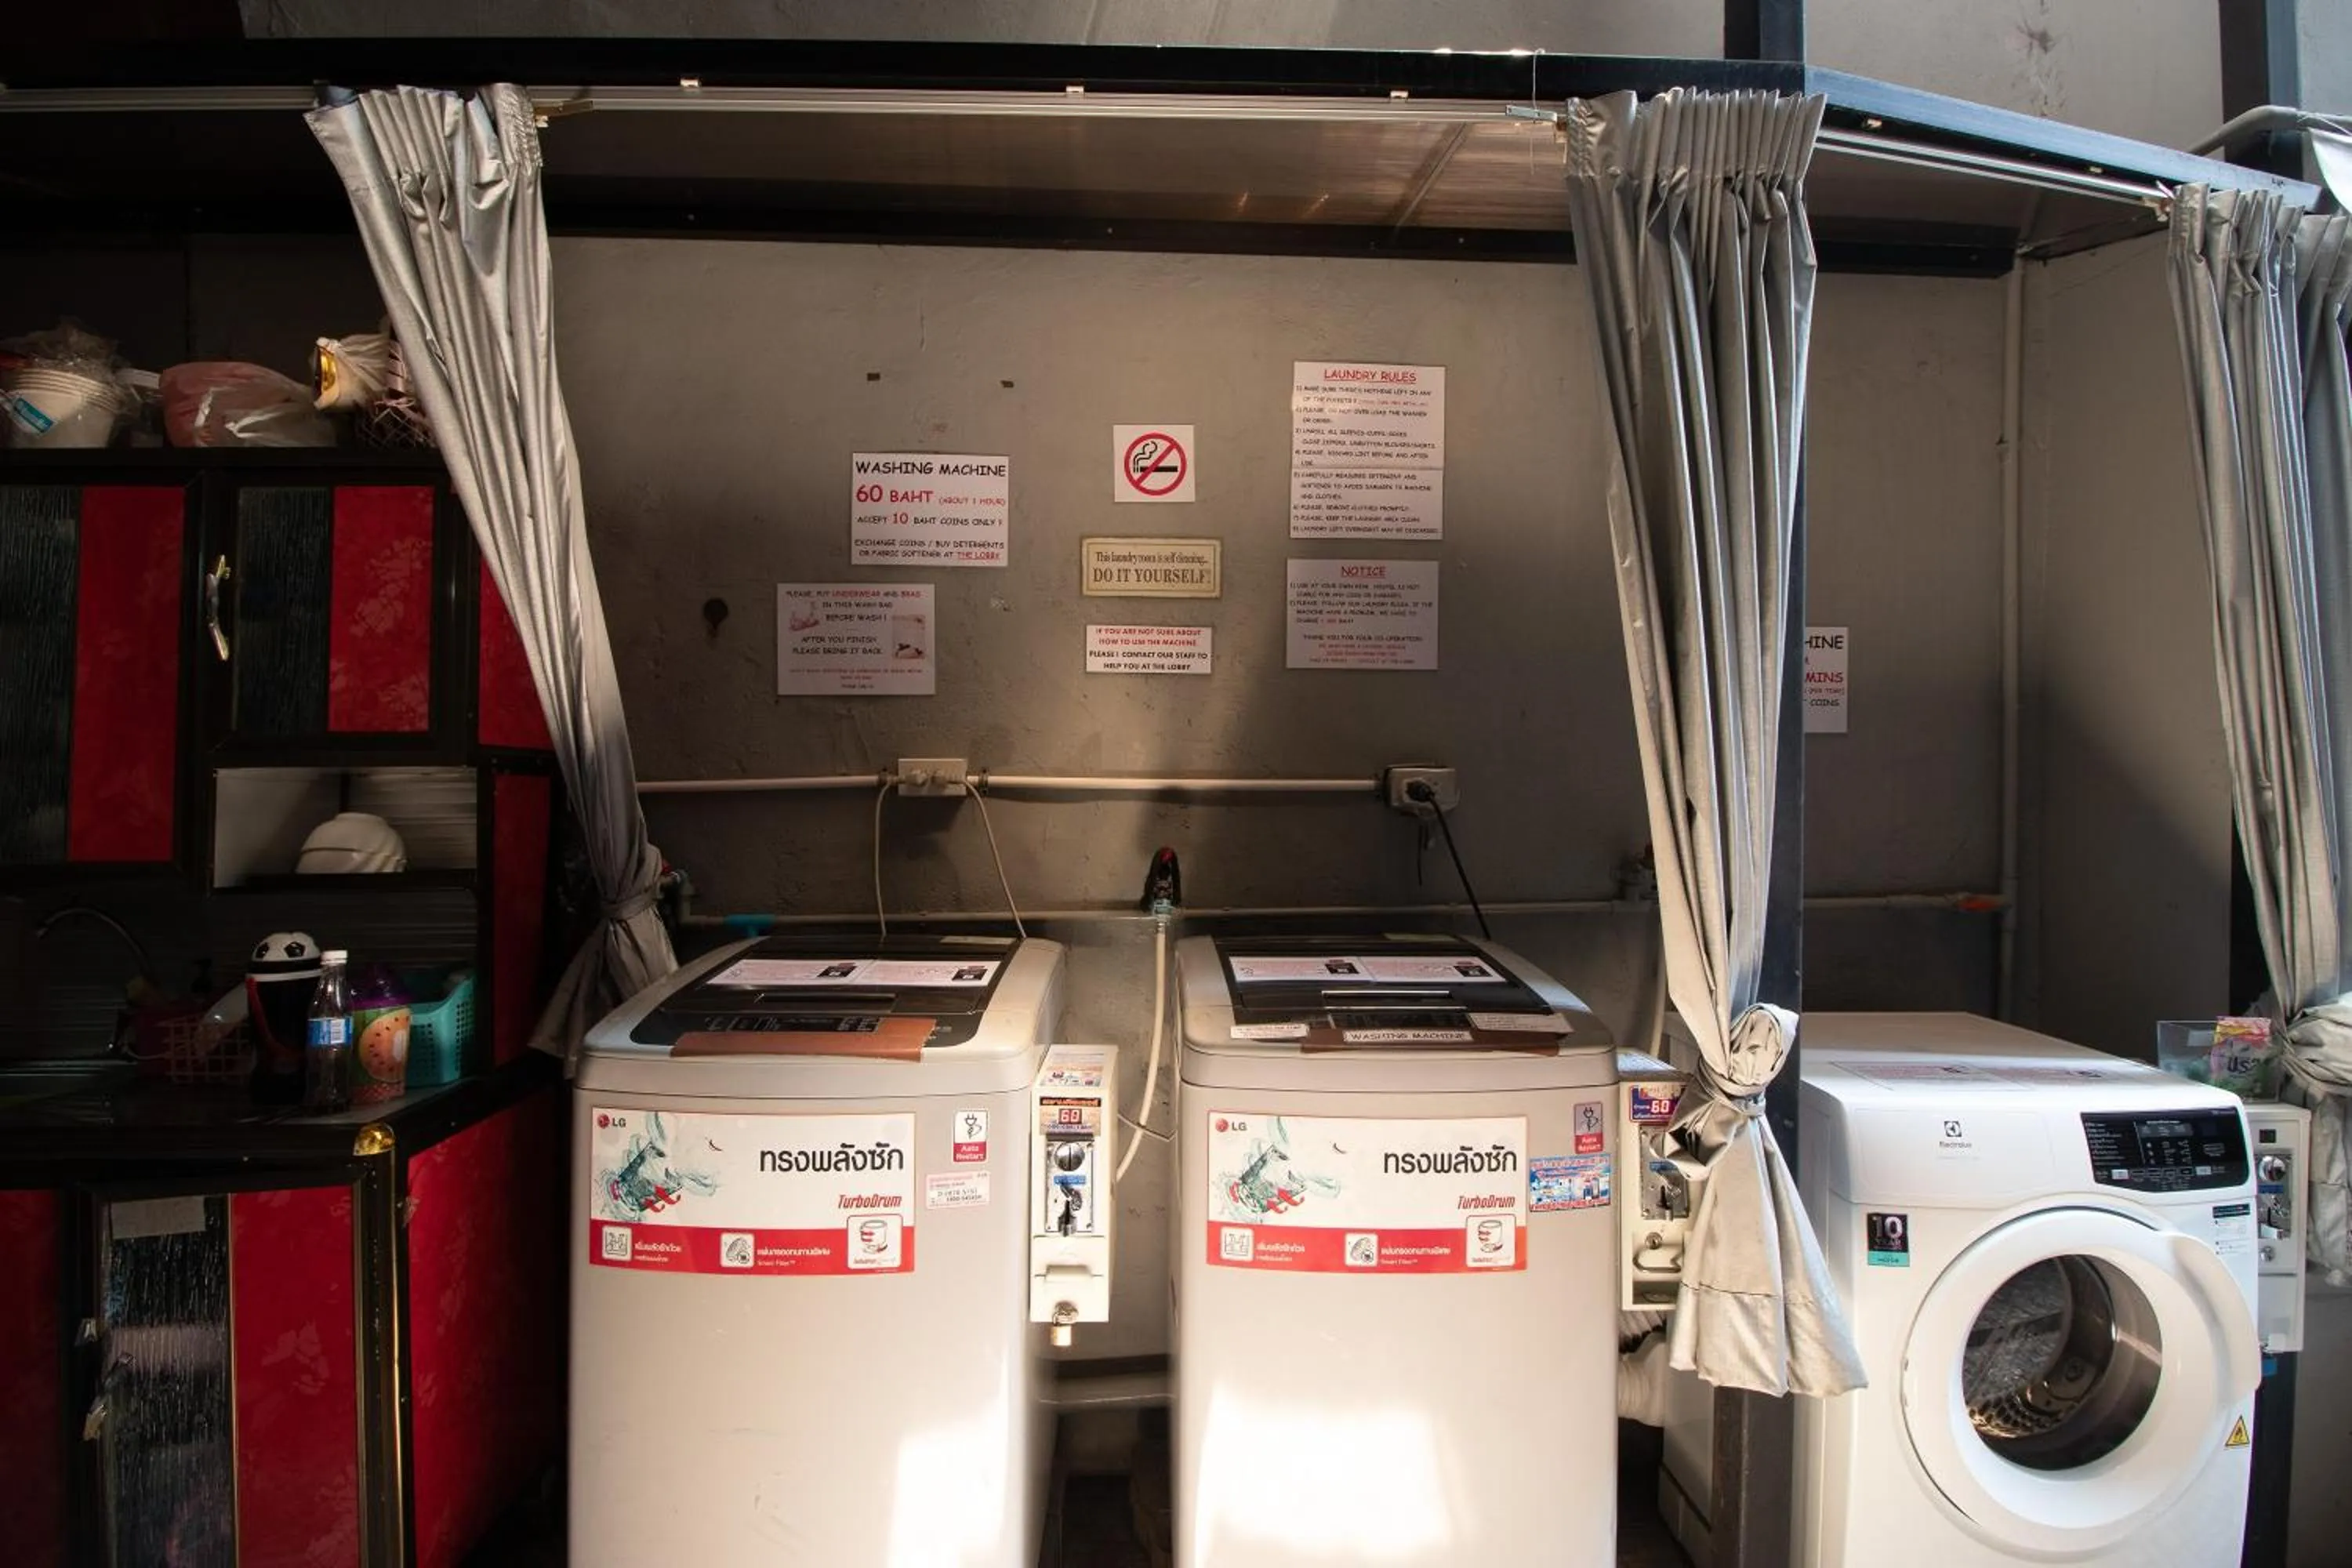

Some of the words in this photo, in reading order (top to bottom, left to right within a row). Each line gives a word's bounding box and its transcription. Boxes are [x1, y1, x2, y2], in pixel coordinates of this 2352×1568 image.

[1324, 369, 1376, 380] LAUNDRY
[1381, 371, 1417, 382] RULES
[855, 461, 934, 474] WASHING
[938, 464, 1006, 477] MACHINE
[856, 485, 883, 503] 60
[890, 491, 934, 503] BAHT
[892, 514, 909, 524] 10
[1096, 552, 1111, 562] This
[1093, 568, 1112, 583] DO
[1116, 568, 1131, 583] IT
[1341, 566, 1386, 577] NOTICE
[1806, 672, 1843, 683] MINS
[1651, 1101, 1669, 1112] 60
[612, 1117, 626, 1127] LG
[1062, 1109, 1080, 1122] 60
[1232, 1121, 1247, 1131] LG
[760, 1142, 904, 1172] ทรงพลังซัก
[1384, 1145, 1517, 1174] ทรงพลังซัก
[838, 1194, 902, 1209] TurboDrum
[1457, 1195, 1515, 1209] TurboDrum
[1872, 1216, 1903, 1238] 10
